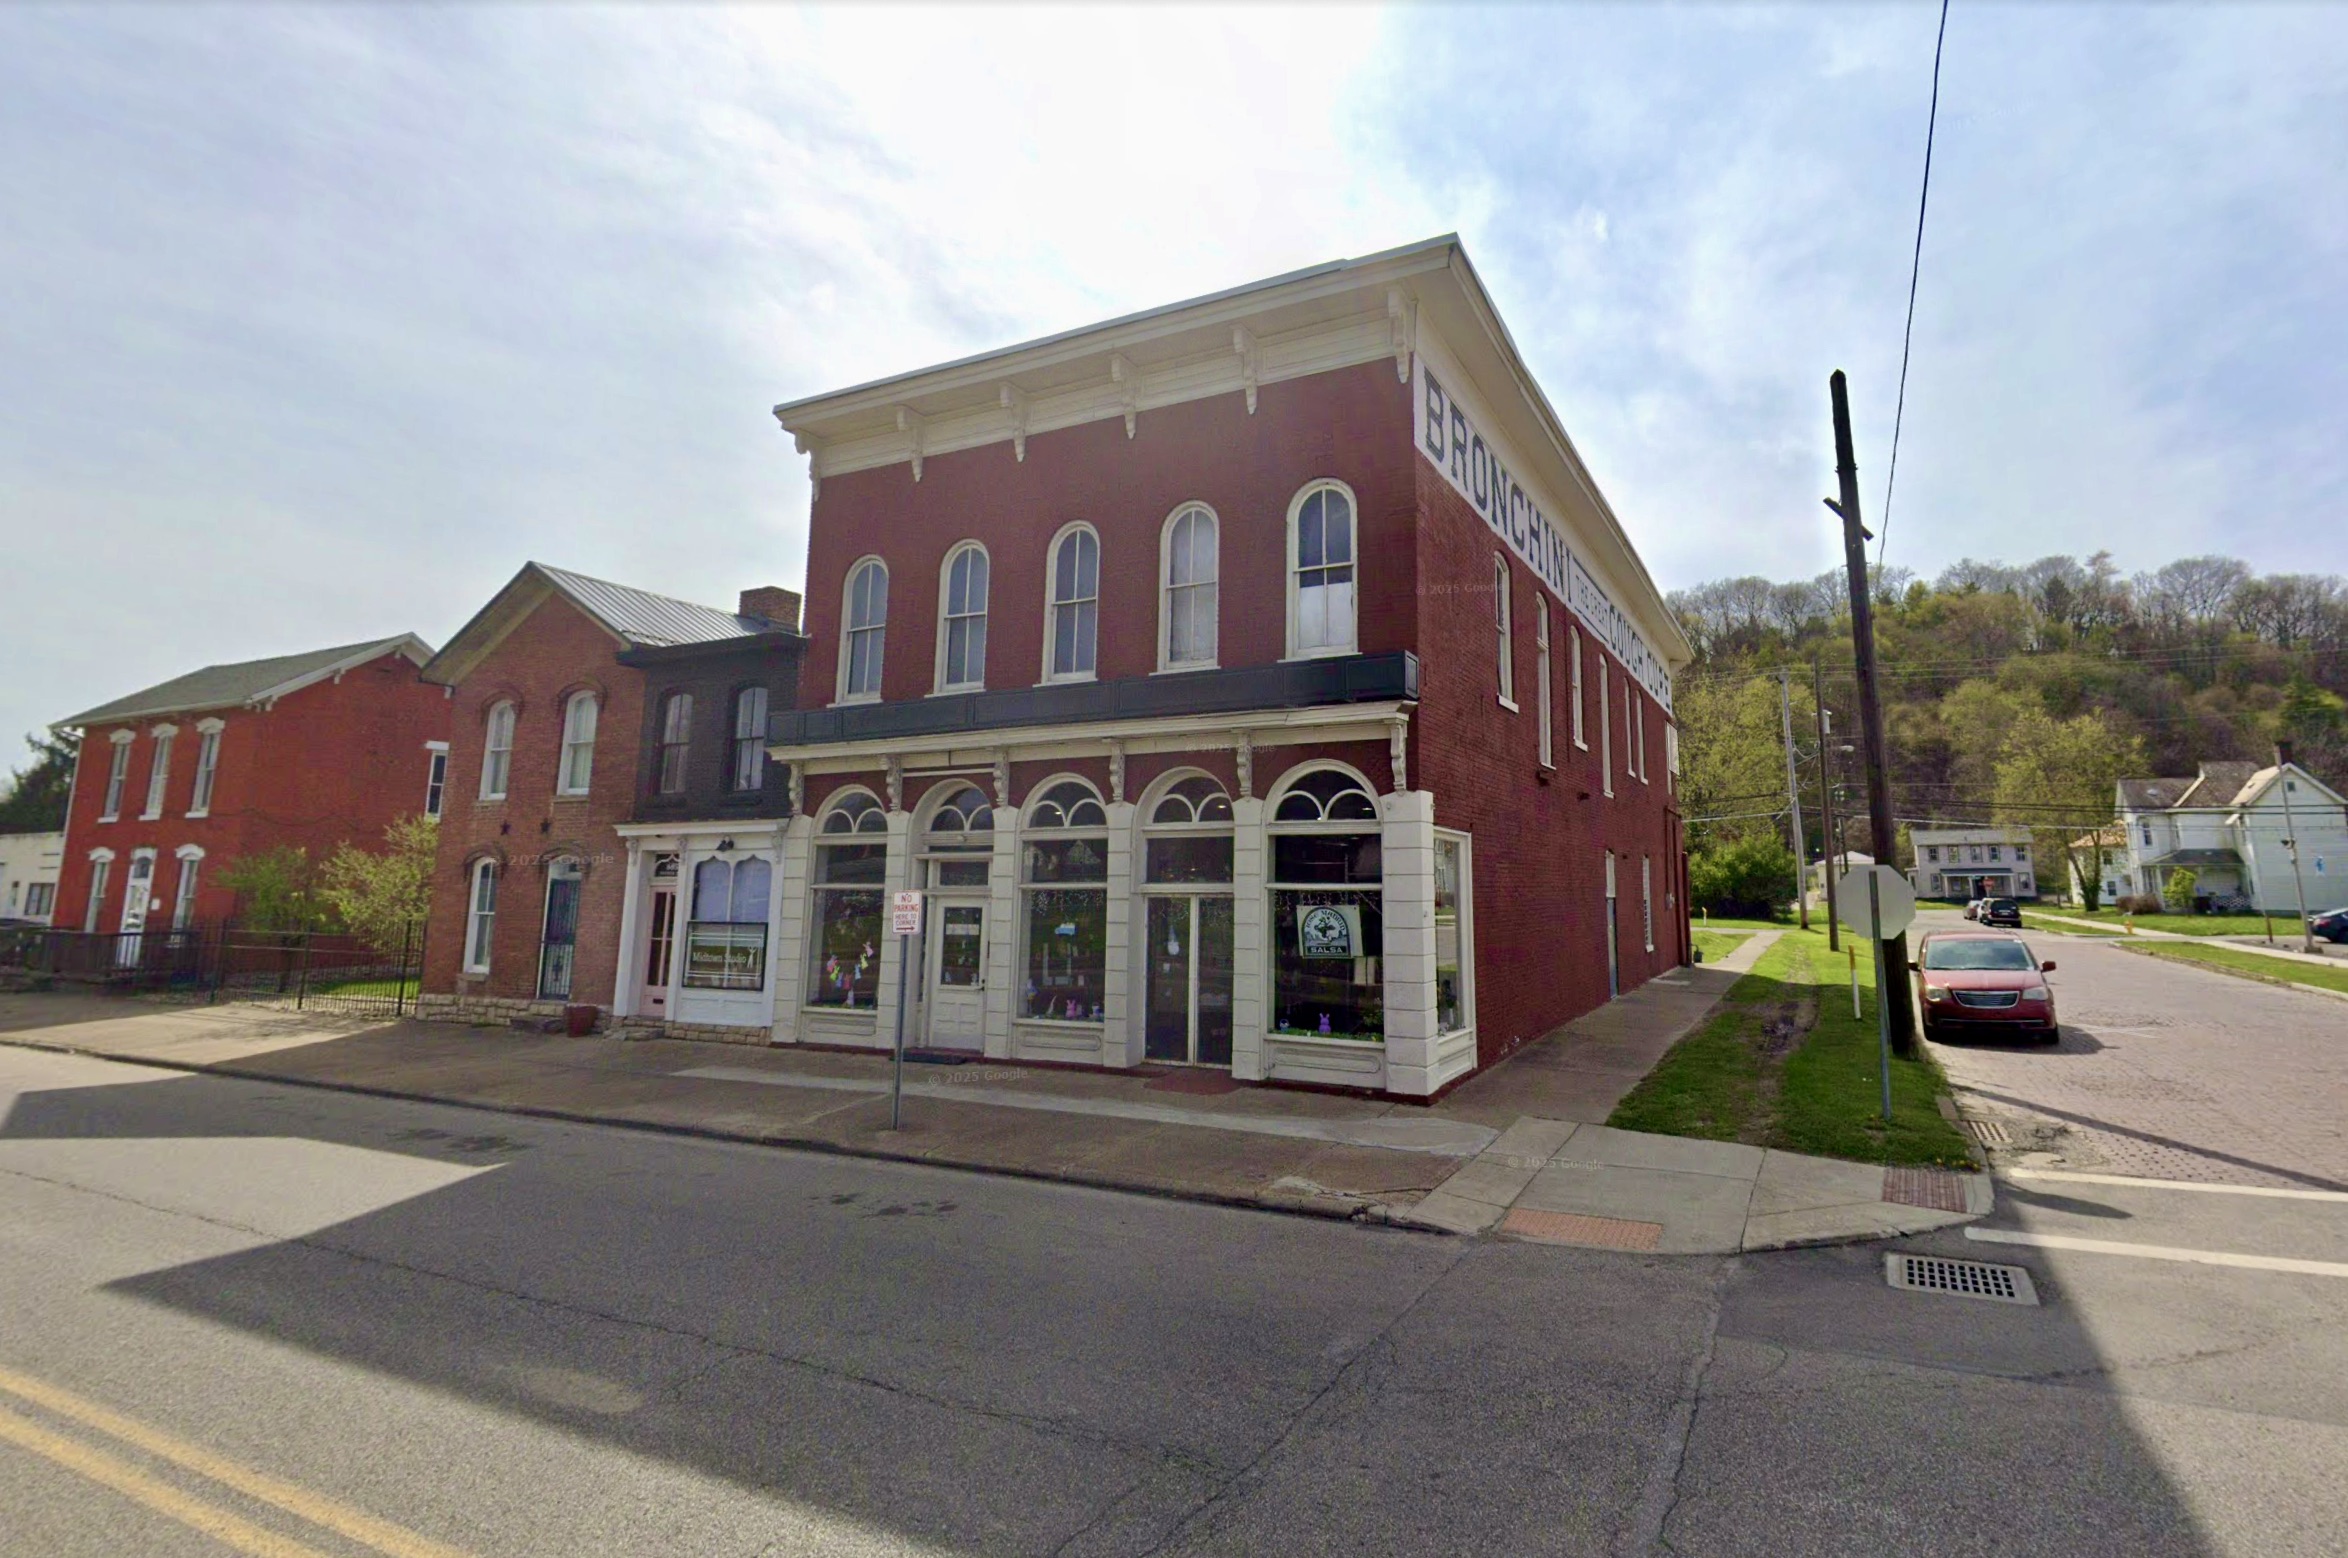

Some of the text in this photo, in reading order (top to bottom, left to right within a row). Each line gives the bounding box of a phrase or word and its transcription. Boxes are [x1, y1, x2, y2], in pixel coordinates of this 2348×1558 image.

[1424, 366, 1572, 604] BRONCHINI
[1576, 575, 1589, 609] THE
[1609, 603, 1643, 682] COUGH
[1647, 650, 1670, 710] CURE
[901, 895, 912, 903] NO
[894, 904, 919, 912] PARKING
[1321, 910, 1346, 931] MADRID
[693, 952, 746, 963] Midtown Studio
